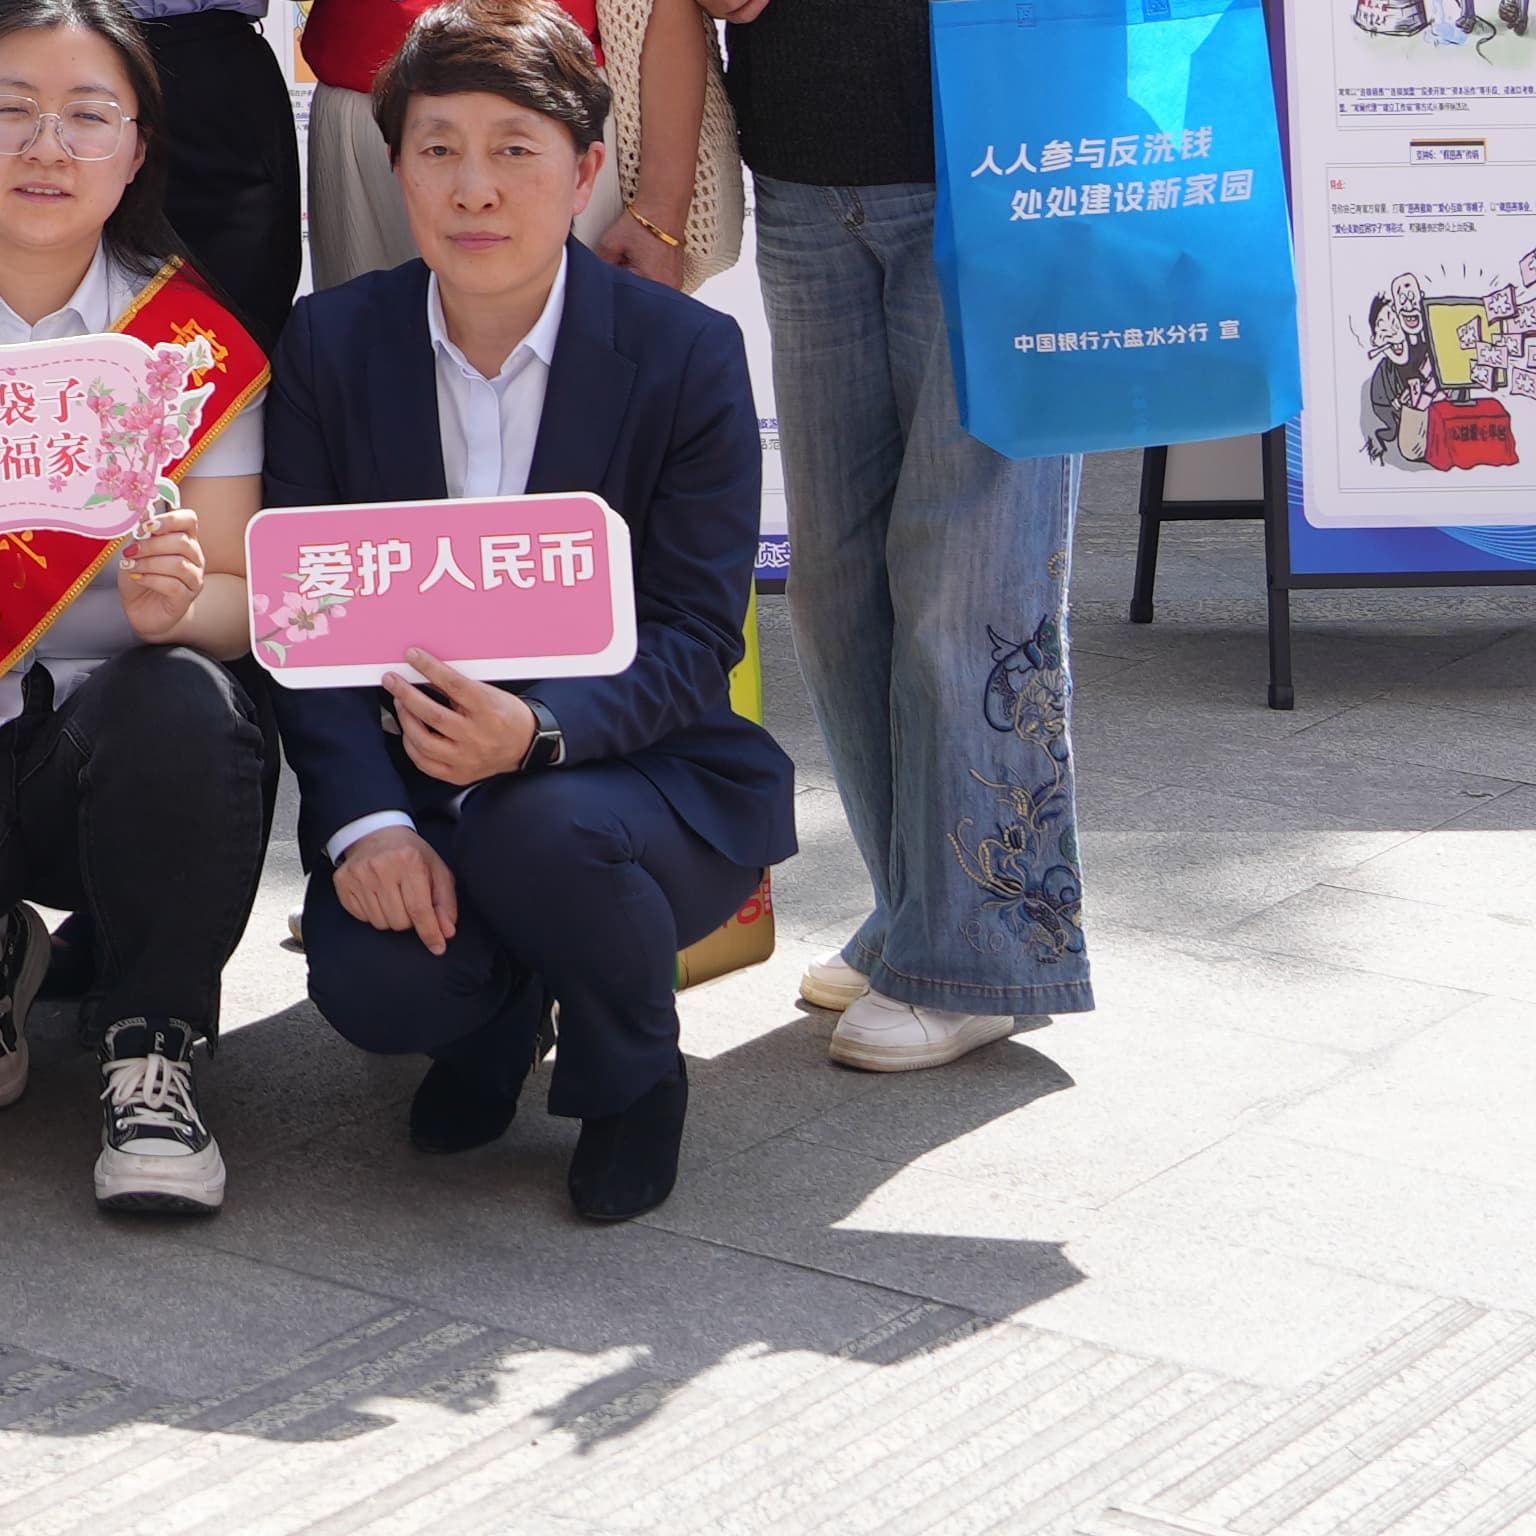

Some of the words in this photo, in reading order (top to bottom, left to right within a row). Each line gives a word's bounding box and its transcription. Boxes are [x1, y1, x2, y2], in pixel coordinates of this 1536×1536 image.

[970, 125, 1214, 178] 人人参与反洗钱
[1009, 168, 1255, 222] 处处建设新家园
[1013, 321, 1210, 354] 中国银行六盘水分行
[1218, 319, 1241, 341] 宣
[297, 529, 595, 600] 爱护人民币
